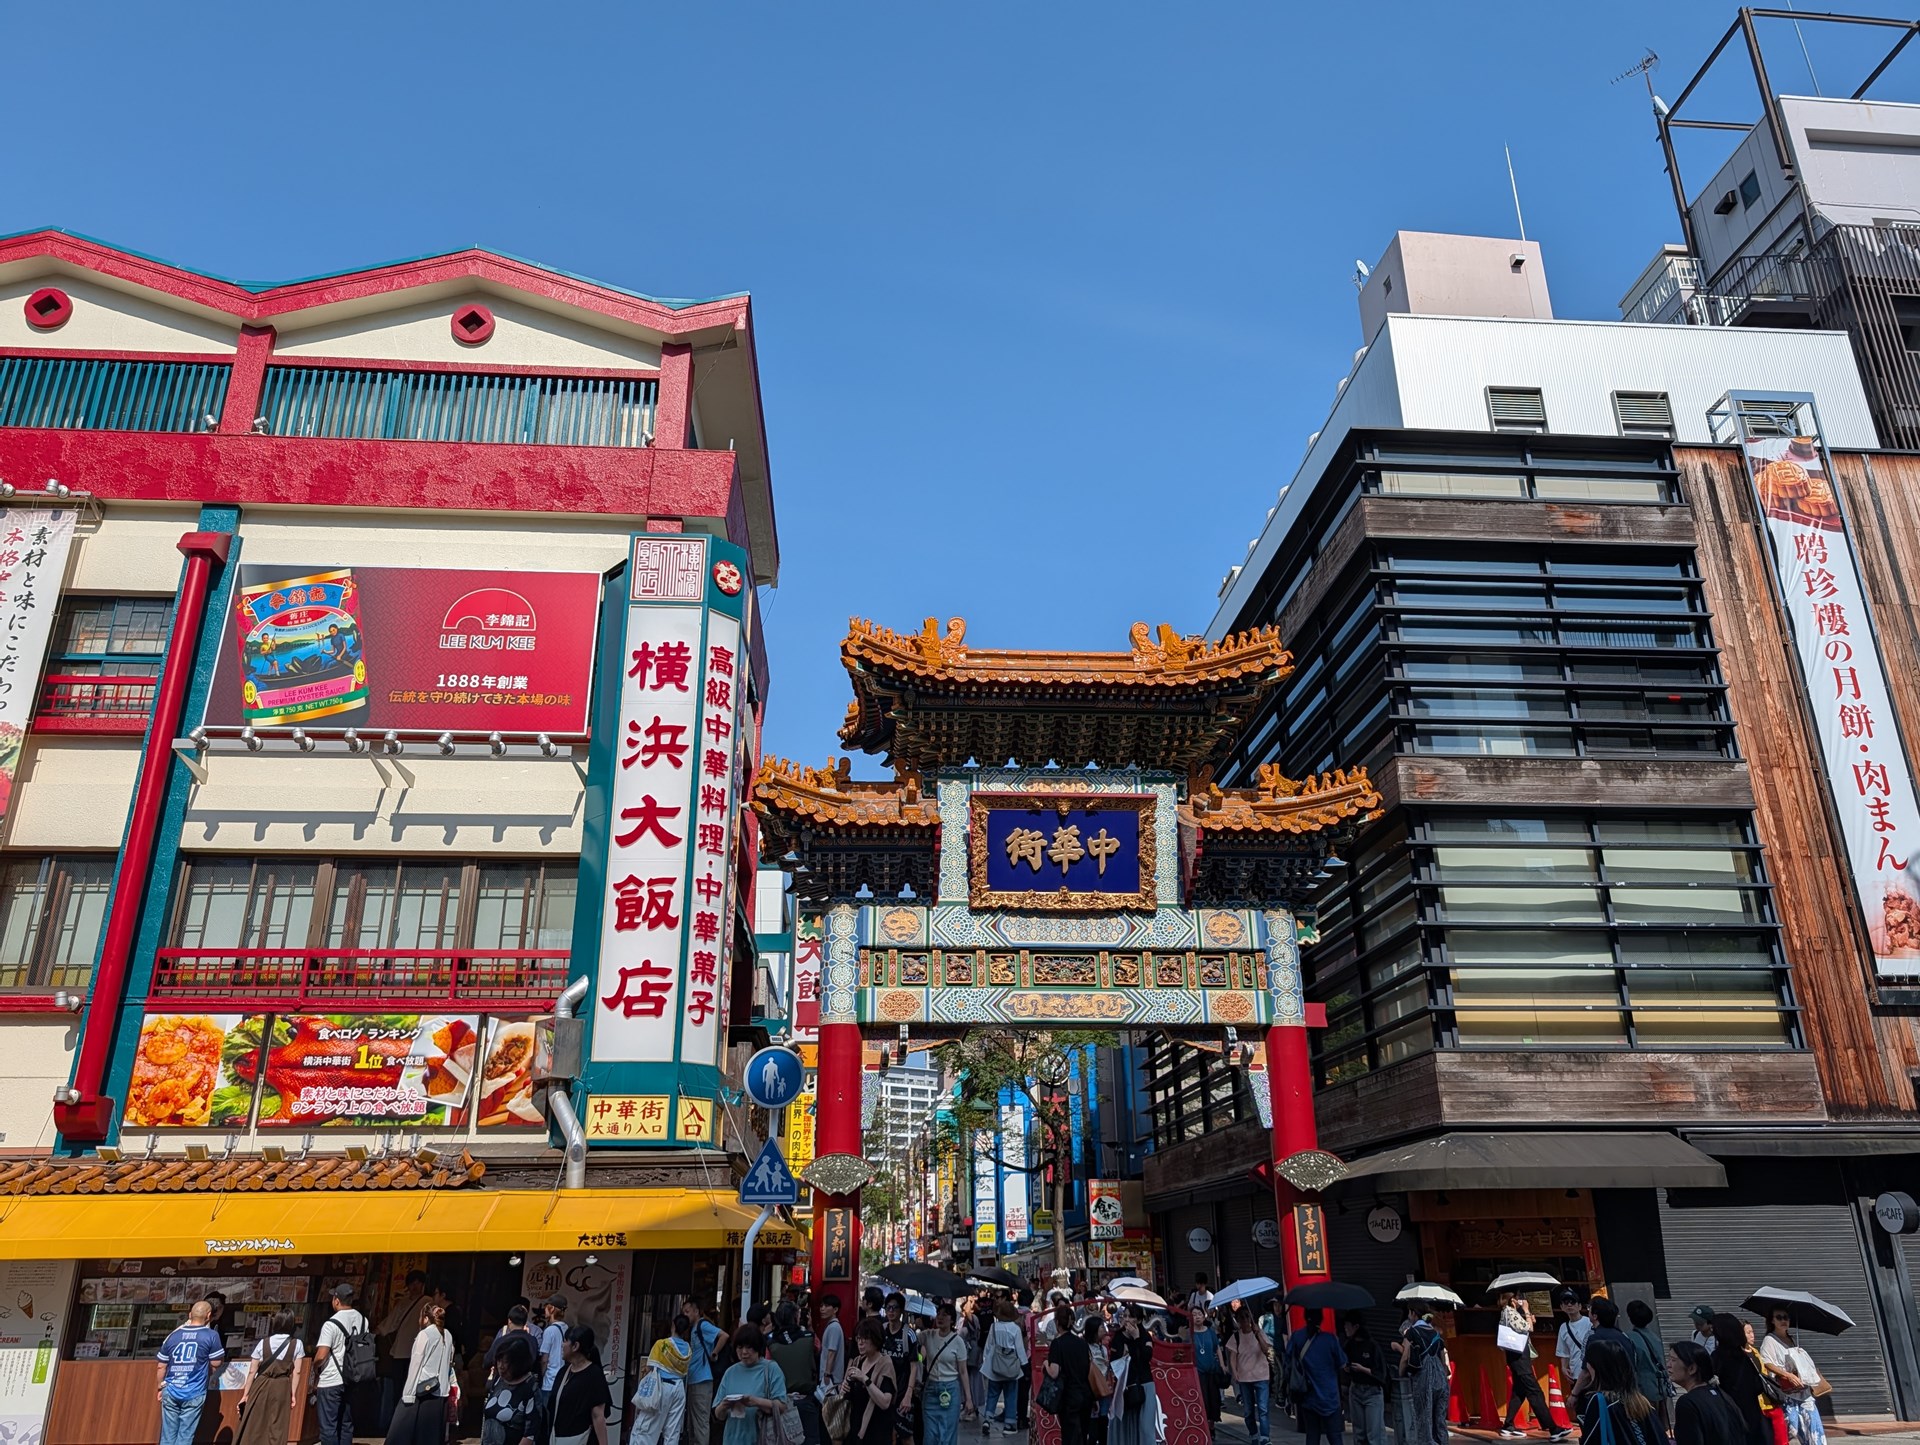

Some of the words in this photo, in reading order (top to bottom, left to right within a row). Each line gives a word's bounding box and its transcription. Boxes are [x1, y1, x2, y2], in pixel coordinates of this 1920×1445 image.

[485, 614, 530, 628] 李錦記
[439, 634, 467, 649] LEE
[469, 635, 504, 649] KUM
[506, 636, 536, 650] KEE
[436, 674, 529, 690] 1888年創業
[267, 696, 296, 706] PREMIUM
[296, 691, 324, 702] OYSTER
[325, 686, 346, 697] SAUCE
[284, 690, 297, 698] LEE
[298, 687, 314, 696] KUM
[314, 683, 328, 692] KEE
[388, 690, 572, 706] 伝統を守り続けてきた本場の味
[305, 702, 318, 710] NET
[602, 641, 692, 1017] 横浜大飯店
[688, 645, 735, 1026] 高級中華料理・中華菓子
[1006, 825, 1121, 875] 中華街
[318, 1028, 363, 1040] 食べログ
[367, 1027, 422, 1040] ランキング
[303, 1055, 351, 1066] 横浜中華街
[354, 1044, 383, 1069] 1位
[386, 1055, 425, 1066] 食べ放題
[301, 1087, 418, 1100] 素材と味にこだわった
[291, 1100, 427, 1115] ワンランク上の食べ放題
[593, 1100, 664, 1120] 中華街
[683, 1102, 706, 1137] 入口
[591, 1121, 663, 1135] 大通り入口
[790, 1098, 802, 1173] 世界一の肉まん
[1886, 1207, 1903, 1221] CAFE
[1381, 1218, 1400, 1230] CAFE
[204, 1237, 295, 1254] アンニンソフトクリーム
[577, 1232, 627, 1247] 大粒甘栗
[172, 1341, 198, 1363] 40
